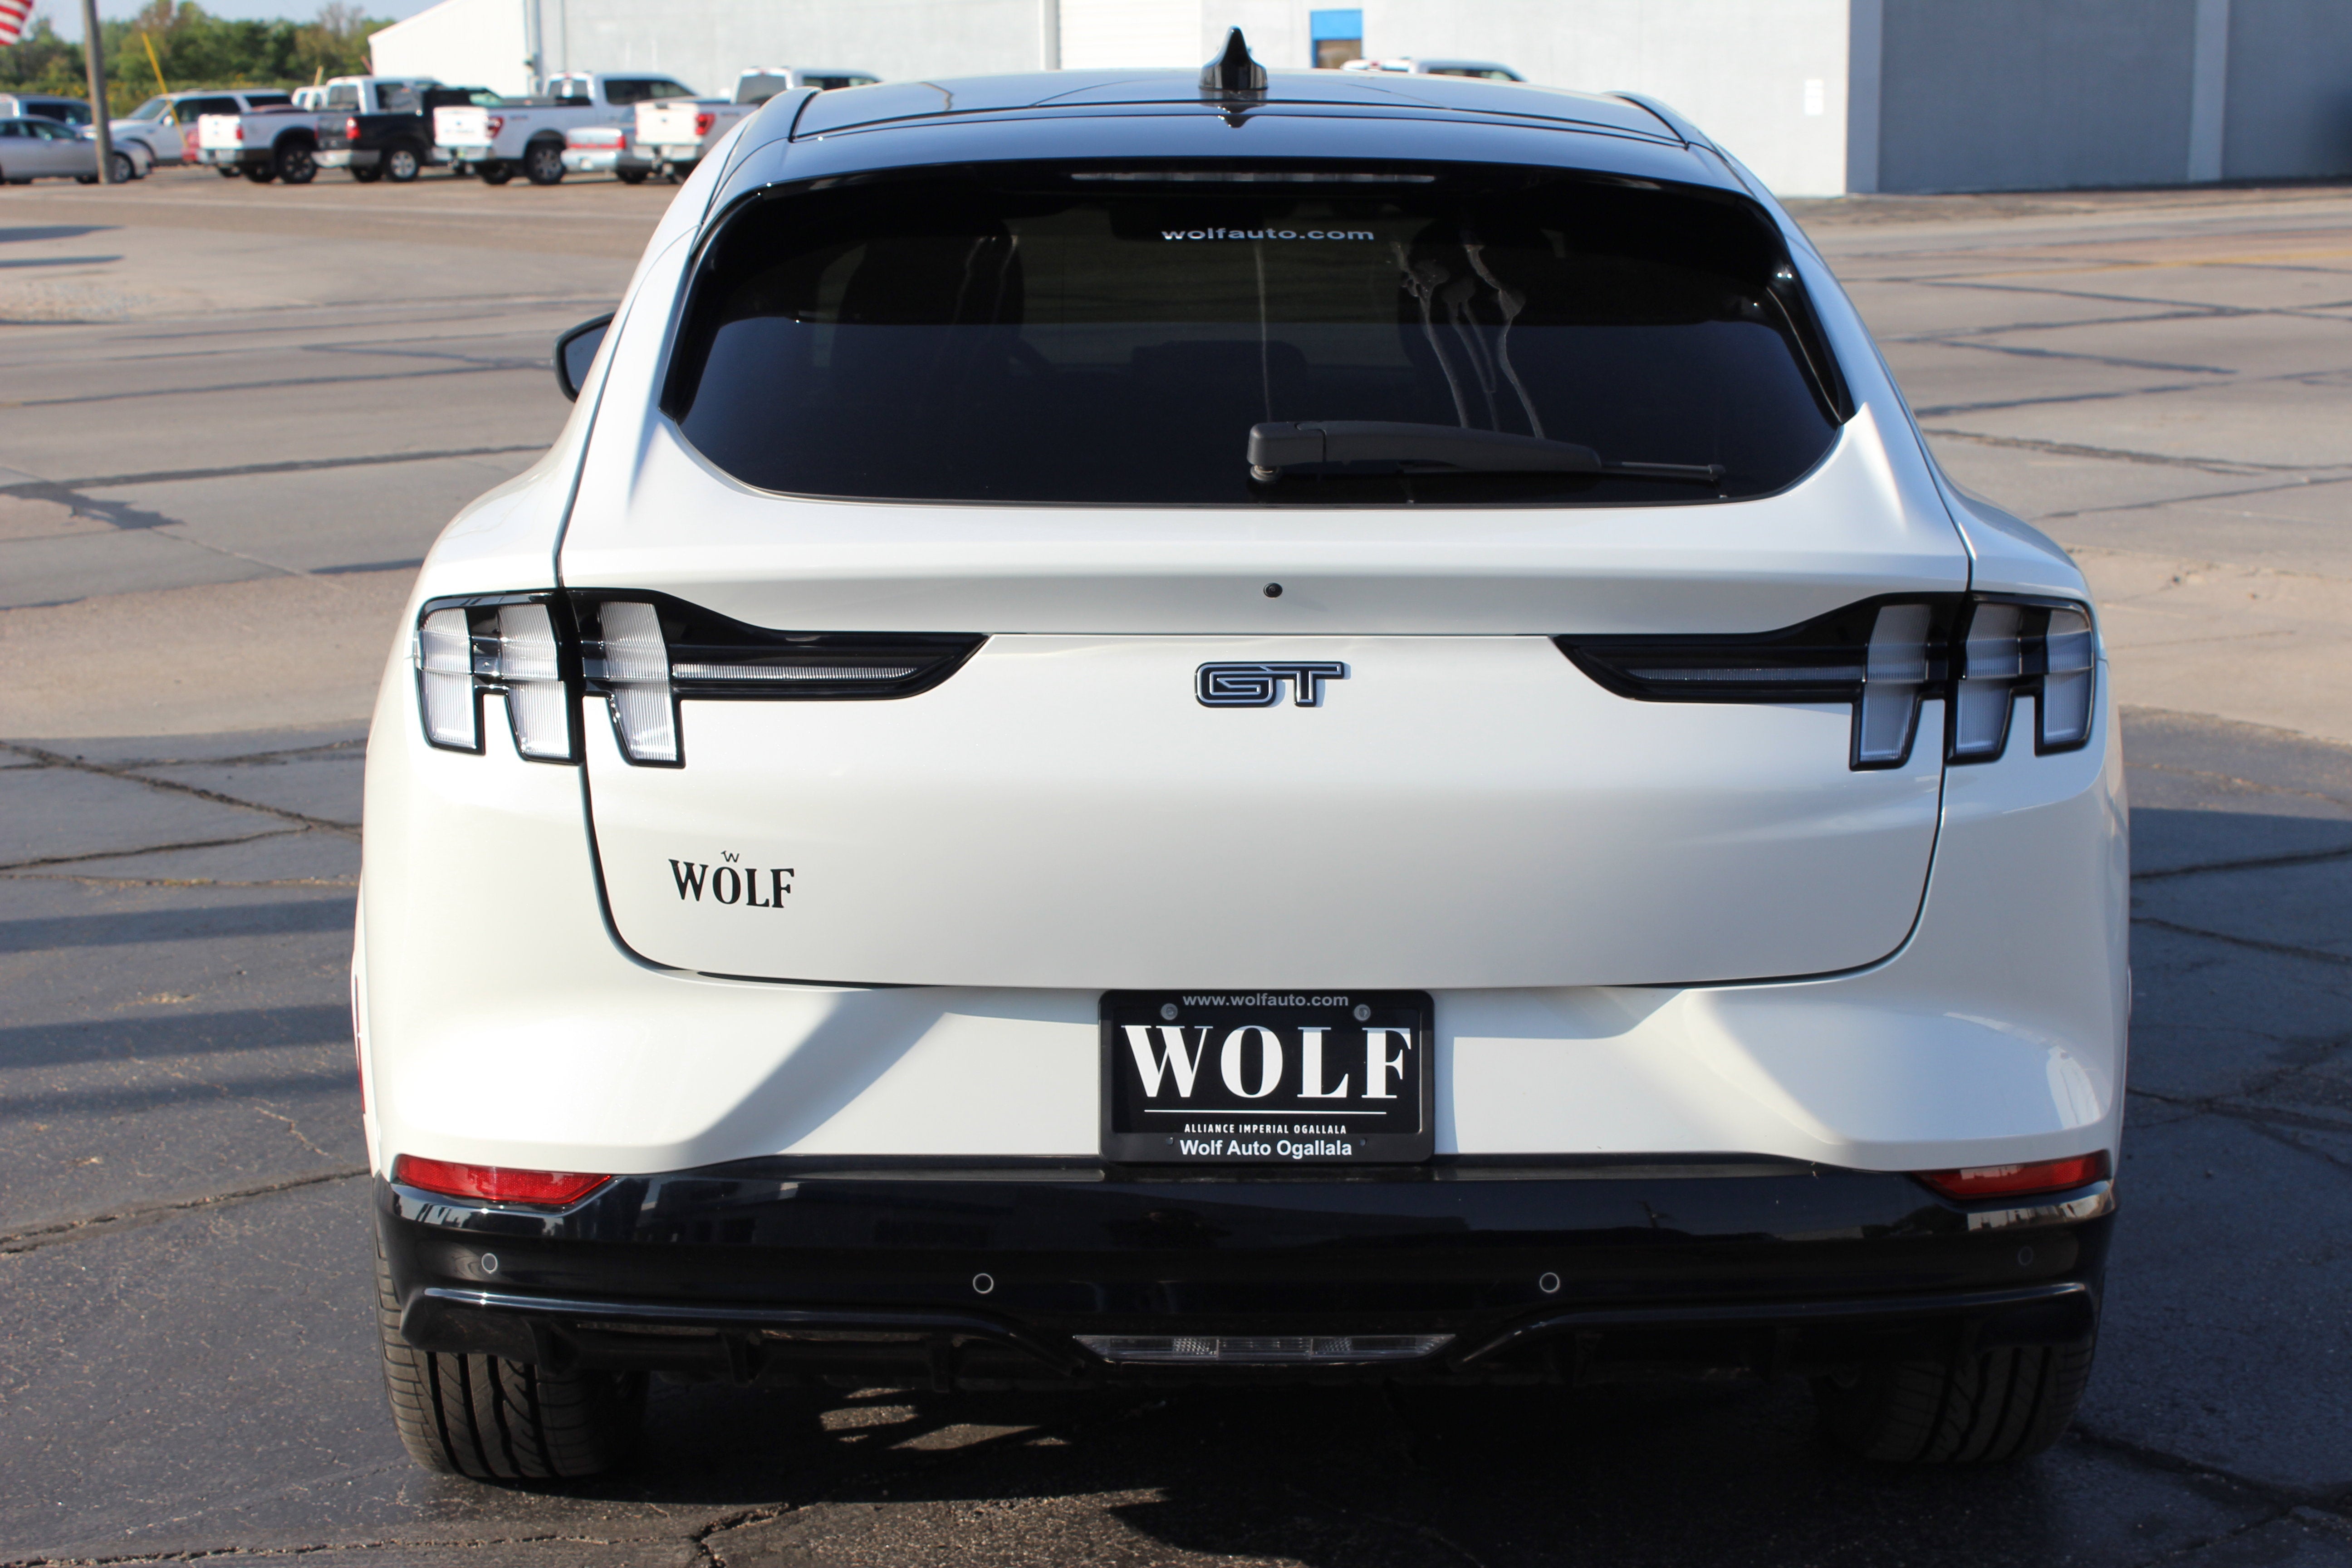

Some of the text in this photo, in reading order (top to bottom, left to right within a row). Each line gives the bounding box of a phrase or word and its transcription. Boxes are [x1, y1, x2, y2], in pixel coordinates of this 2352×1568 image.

[1161, 228, 1374, 240] wolfauto.com
[1195, 661, 1345, 708] GT
[668, 858, 795, 908] WOLF
[1182, 993, 1349, 1006] www.wolfauto.com
[1121, 1024, 1412, 1099] WOLF
[1184, 1123, 1347, 1134] ALLIANCE IMPERIAL OGALLALA
[1179, 1139, 1352, 1160] Wolf Auto Ogallala
